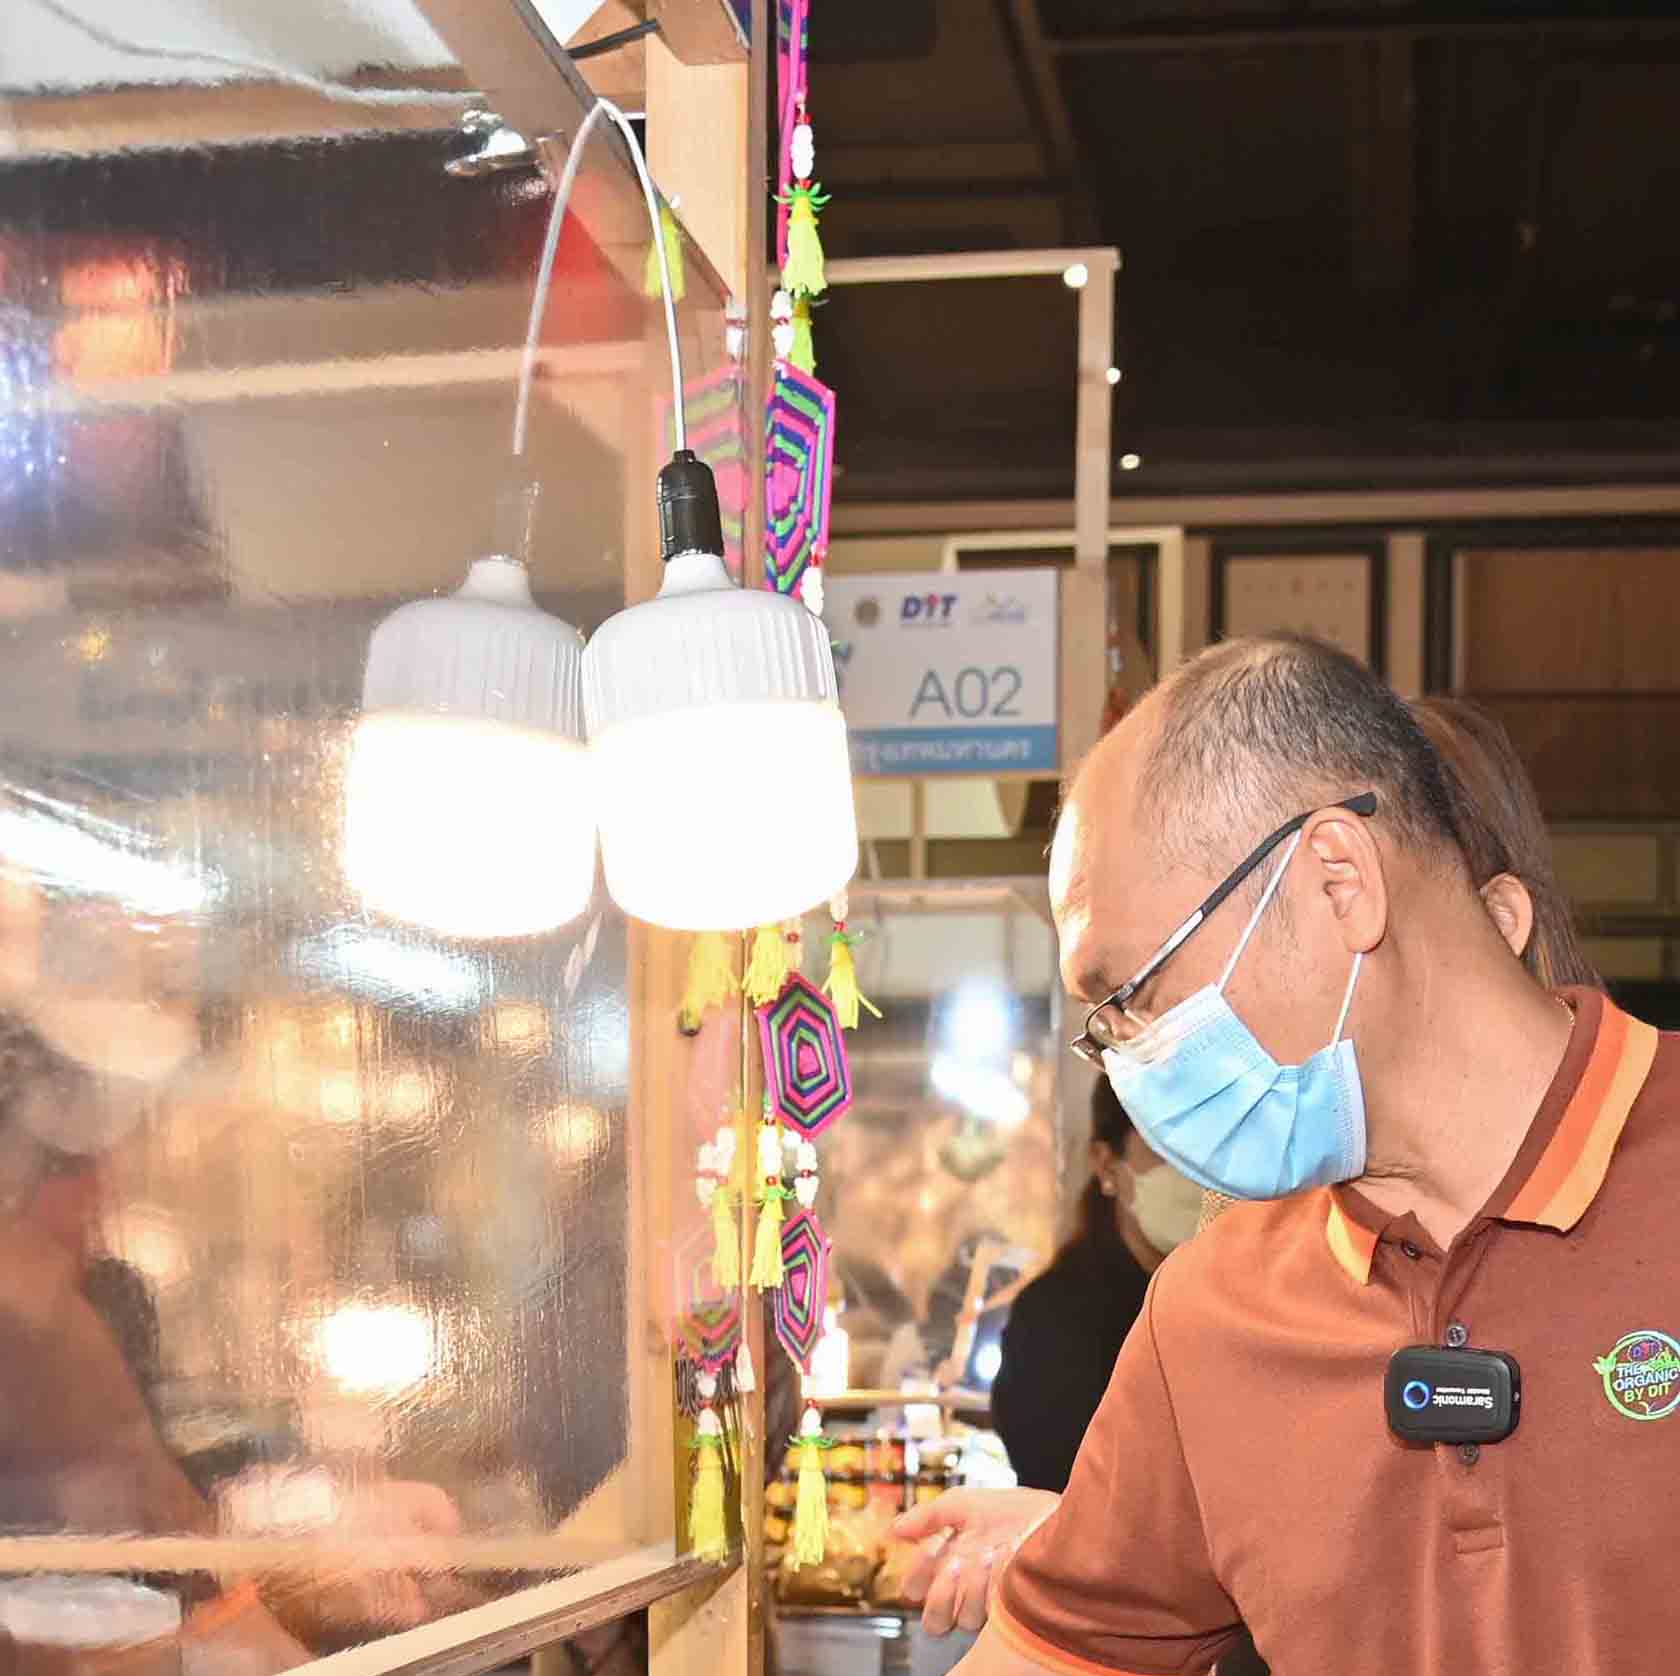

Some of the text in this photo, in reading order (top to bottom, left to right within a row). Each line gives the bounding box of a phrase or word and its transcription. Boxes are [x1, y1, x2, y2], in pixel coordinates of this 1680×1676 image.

[908, 666, 1022, 718] A02
[1613, 1367, 1680, 1392] ORGANIC
[1617, 1365, 1644, 1378] THE
[1432, 1394, 1494, 1409] Saramonic
[1624, 1382, 1671, 1403] BY DIT
